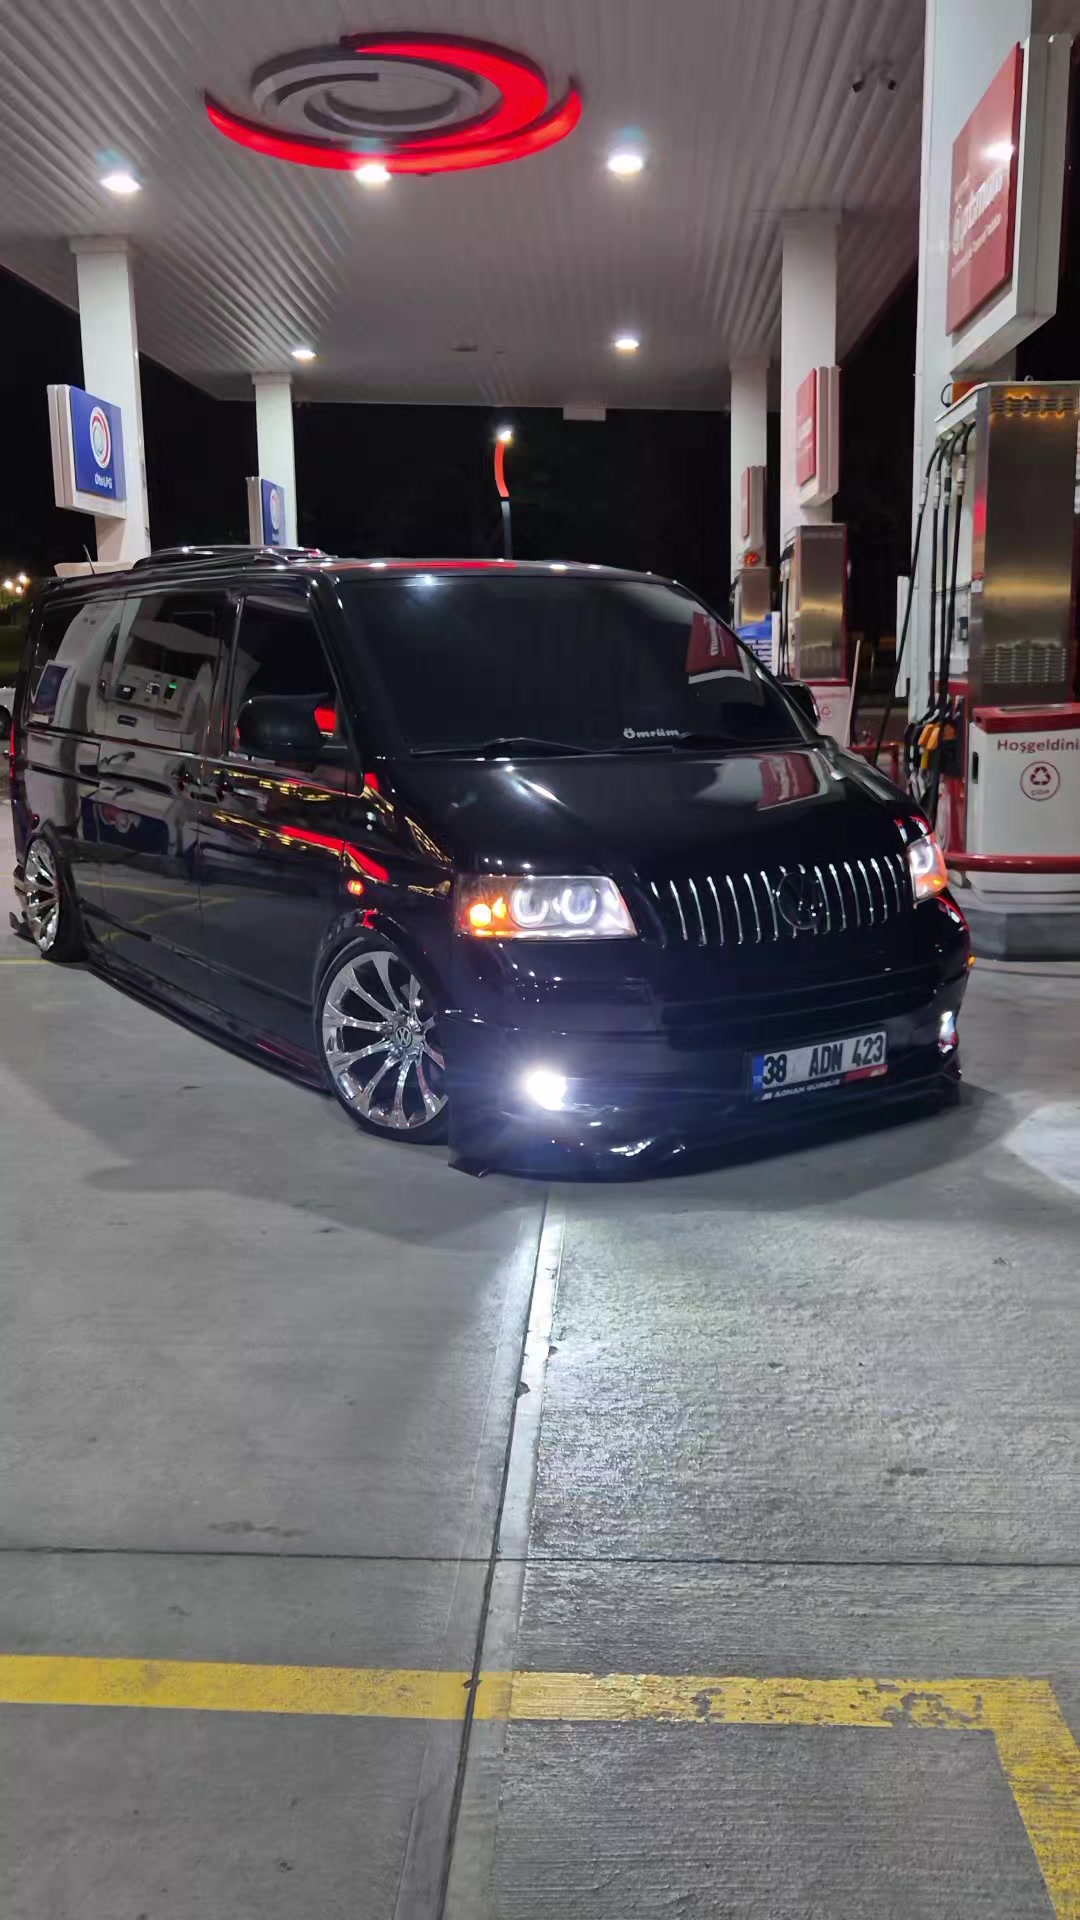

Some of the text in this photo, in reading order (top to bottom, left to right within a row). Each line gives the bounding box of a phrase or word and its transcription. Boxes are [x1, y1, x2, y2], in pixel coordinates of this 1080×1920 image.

[997, 738, 1080, 754] Hoşgeldini
[762, 1034, 884, 1085] 38 ADN 423
